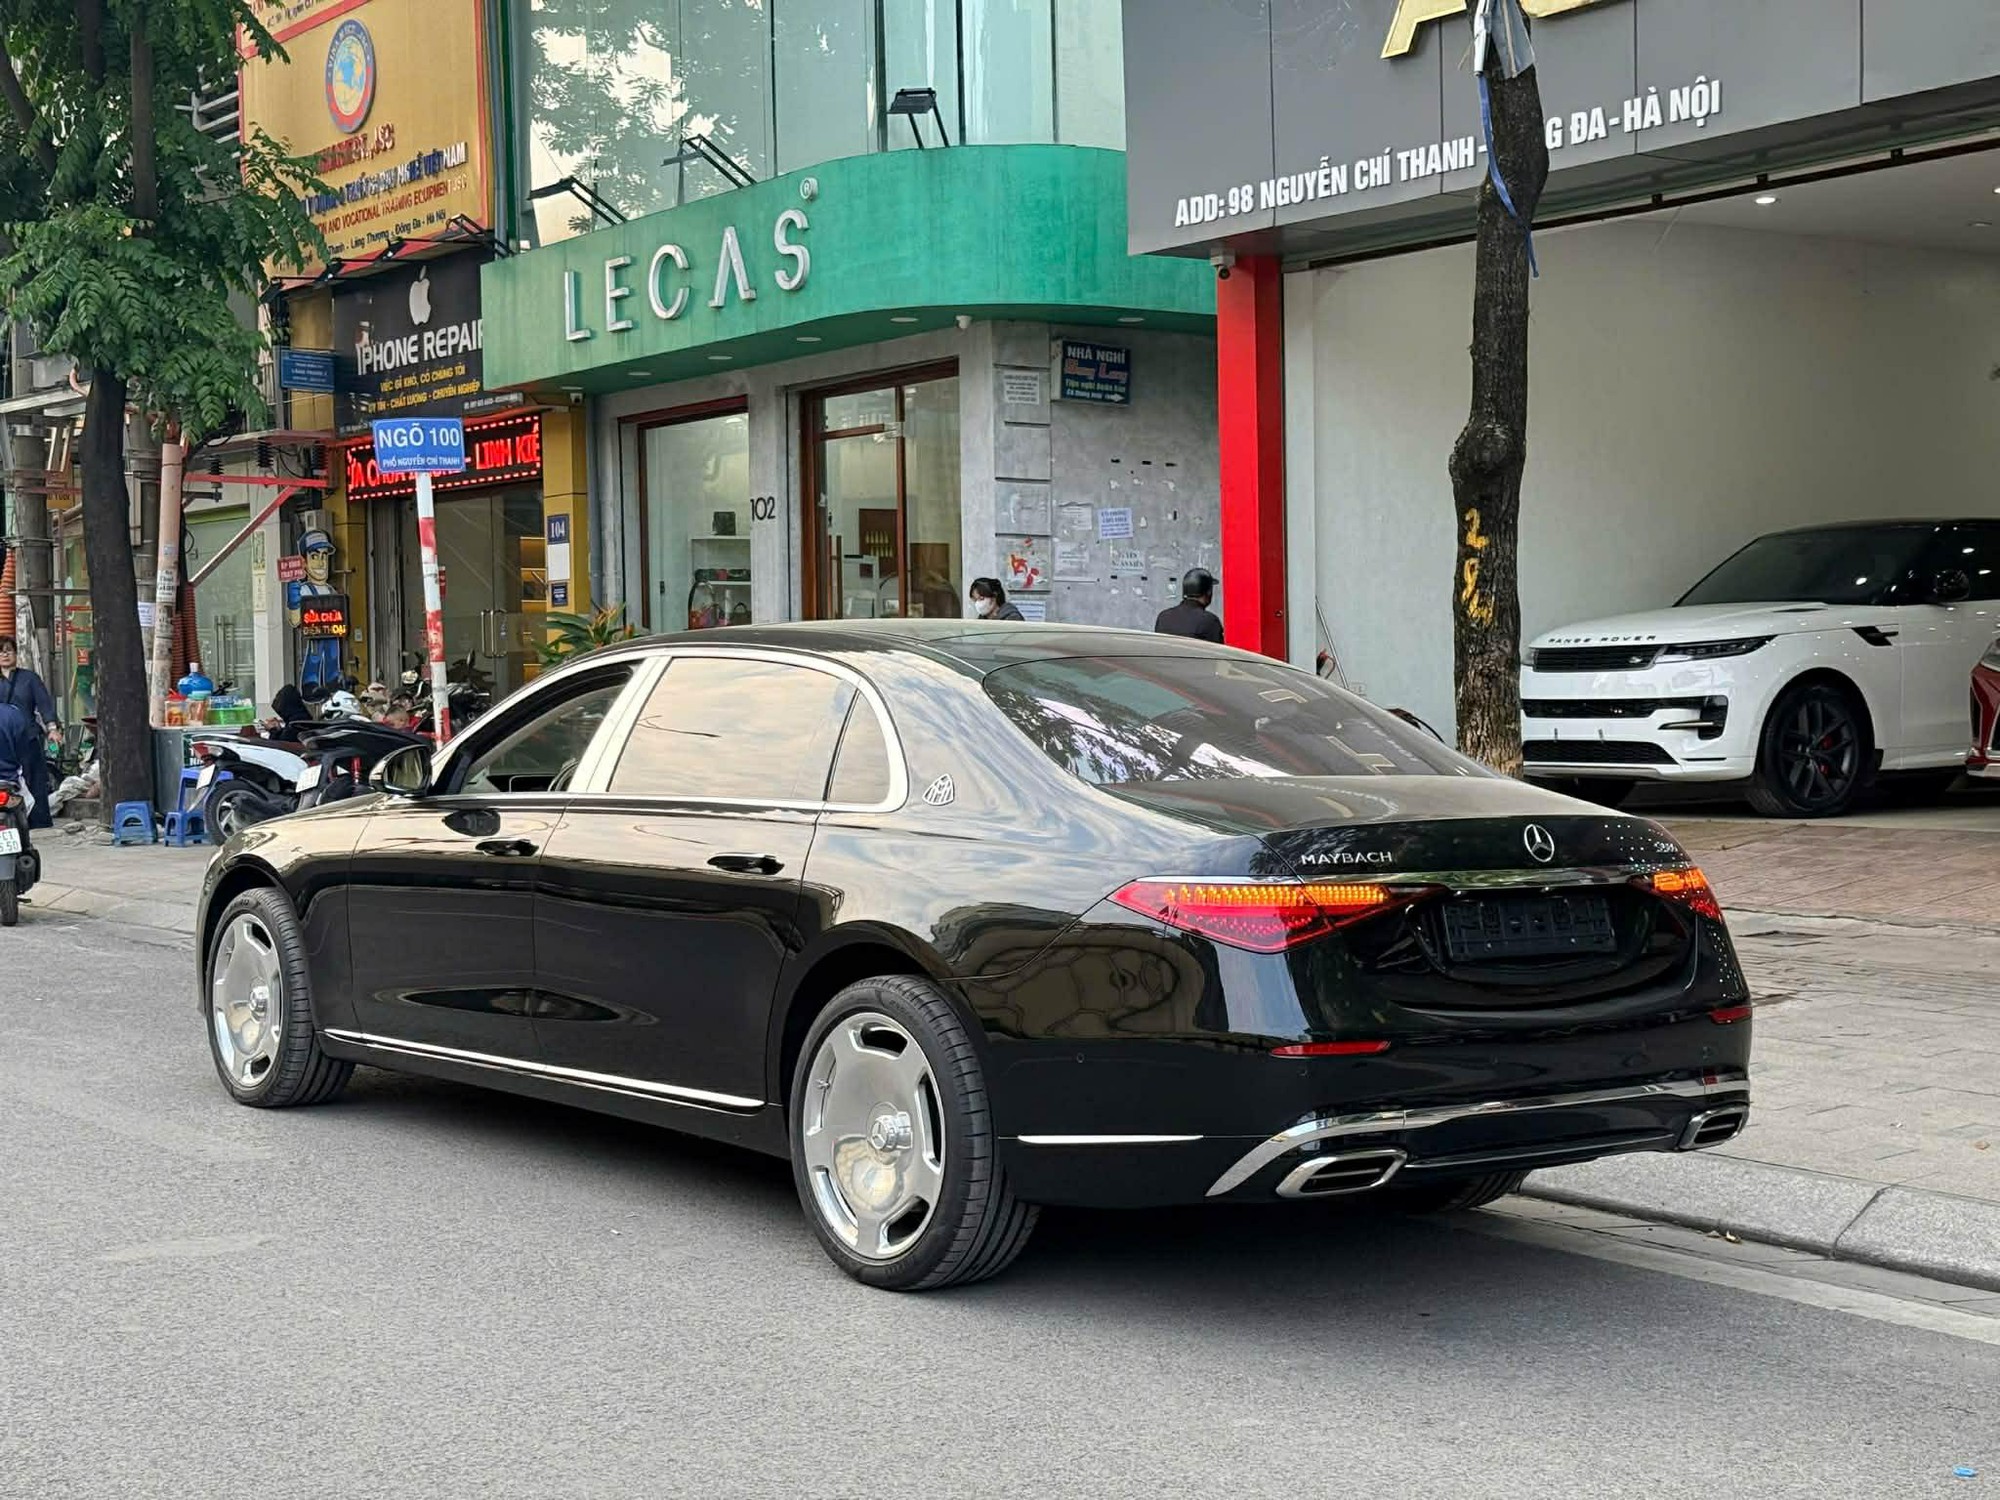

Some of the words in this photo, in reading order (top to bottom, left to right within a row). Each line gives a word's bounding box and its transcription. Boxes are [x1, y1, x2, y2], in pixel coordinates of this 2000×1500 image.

[443, 141, 468, 170] NAM
[1260, 155, 1347, 211] NGUYỄN
[1354, 147, 1391, 192] CHÍ
[1669, 75, 1721, 127] NỘI
[328, 219, 342, 235] AND
[342, 206, 381, 229] VOCATIONAL
[382, 194, 413, 216] TRAINING
[413, 180, 452, 206] EQUIPMENT
[355, 333, 419, 376] IPHONE
[1067, 345, 1092, 360] NHÀ
[420, 370, 430, 384] CÓ
[379, 422, 424, 448] NGÕ
[429, 427, 460, 447] 100
[383, 455, 396, 468] PHỐ
[397, 453, 425, 467] NGUYỄN
[475, 438, 512, 470] LINH
[750, 496, 776, 522] 102
[551, 521, 566, 539] 104
[1600, 634, 1656, 643] ROVER
[1300, 849, 1393, 867] MAYBACH
